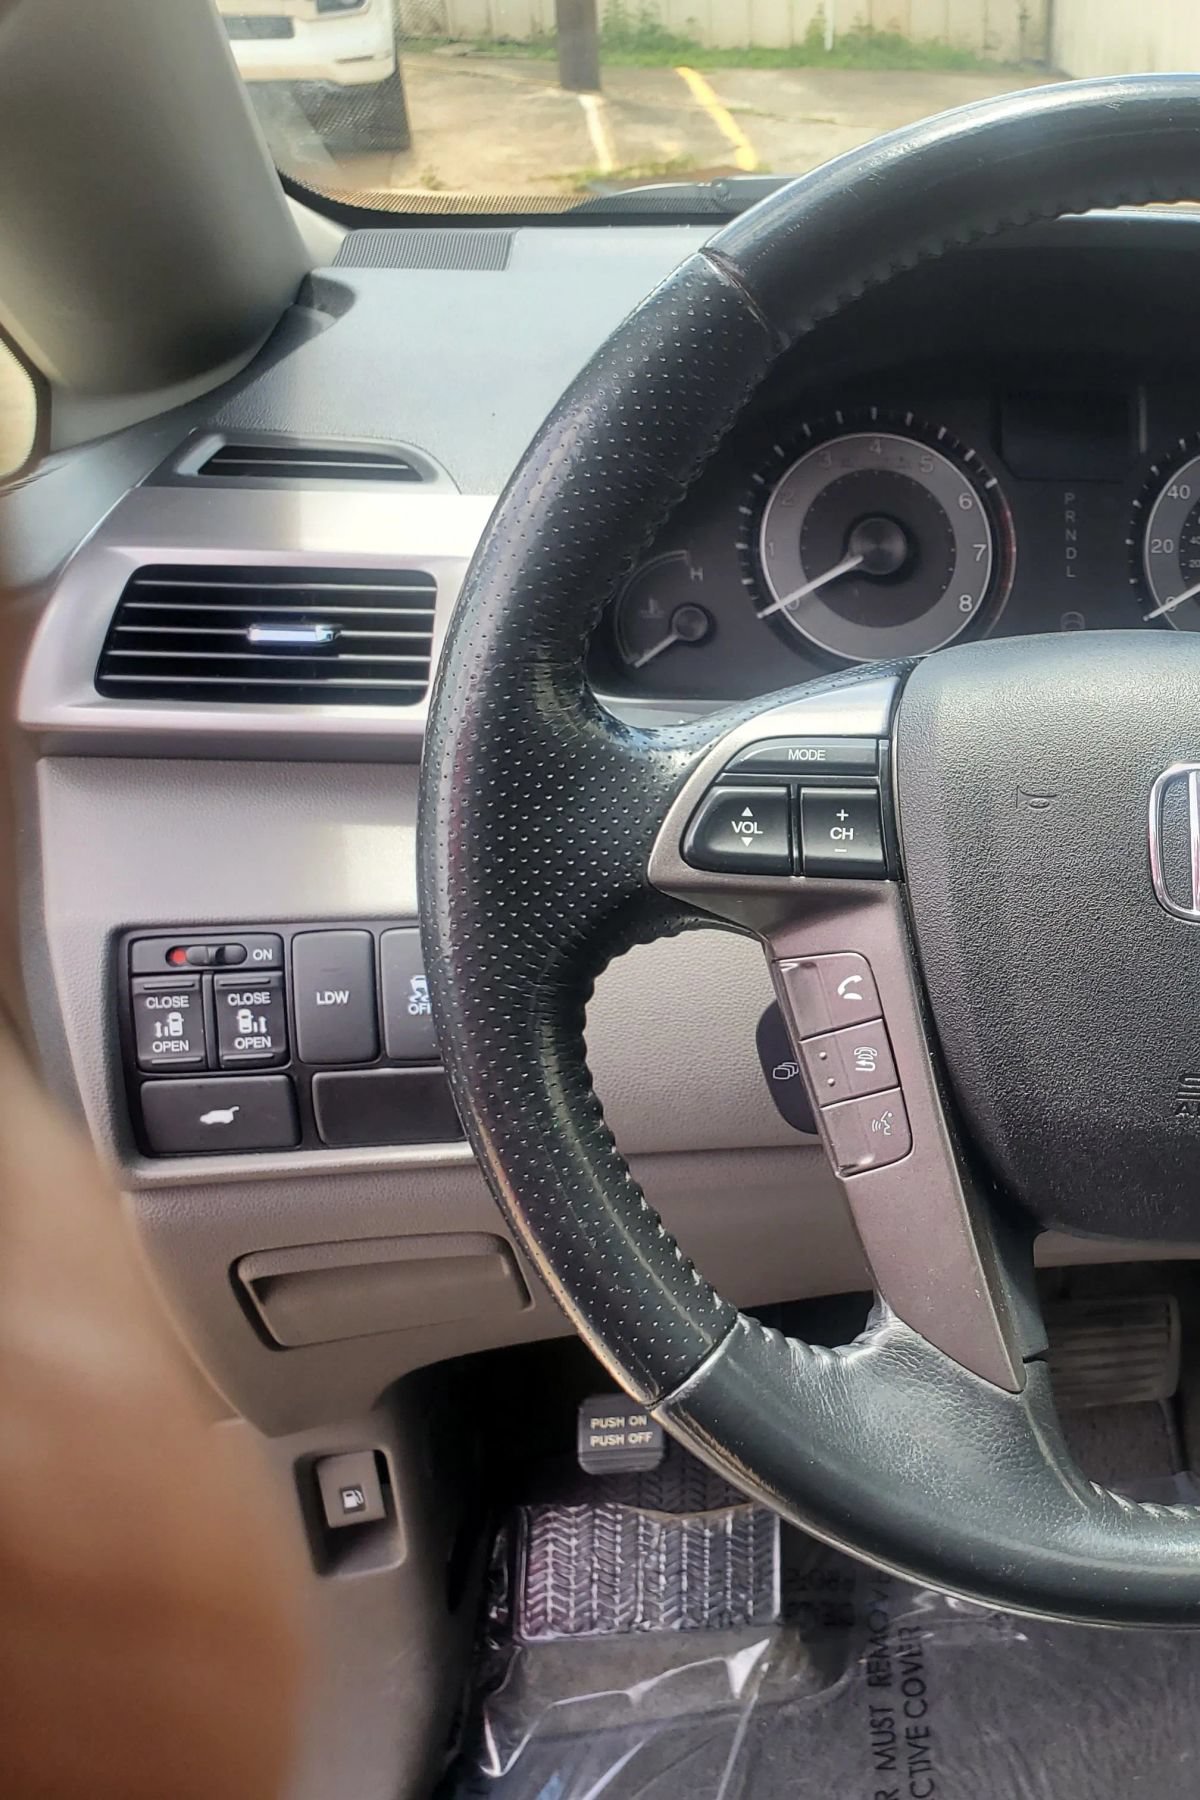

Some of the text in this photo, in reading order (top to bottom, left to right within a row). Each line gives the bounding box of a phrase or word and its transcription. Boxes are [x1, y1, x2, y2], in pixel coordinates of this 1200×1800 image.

[920, 457, 933, 473] 5
[1166, 485, 1191, 499] 40
[959, 493, 973, 510] 6
[1064, 492, 1077, 577] P R N D L
[973, 544, 987, 561] 7
[1151, 539, 1174, 554] 20
[959, 595, 972, 612] 8
[788, 749, 825, 761] MODE
[732, 821, 763, 834] VOL
[830, 827, 854, 840] CH
[253, 949, 272, 961] ON
[146, 996, 189, 1009] CLOSE
[228, 992, 271, 1005] CLOSE
[316, 991, 349, 1005] LDW
[152, 1040, 189, 1053] OPEN
[234, 1036, 271, 1050] OPEN
[590, 1415, 647, 1429] PUSH ON
[590, 1432, 653, 1447] PUSH OFF
[898, 1625, 935, 1800] CTIVE COVER
[869, 1705, 897, 1770] MUST
